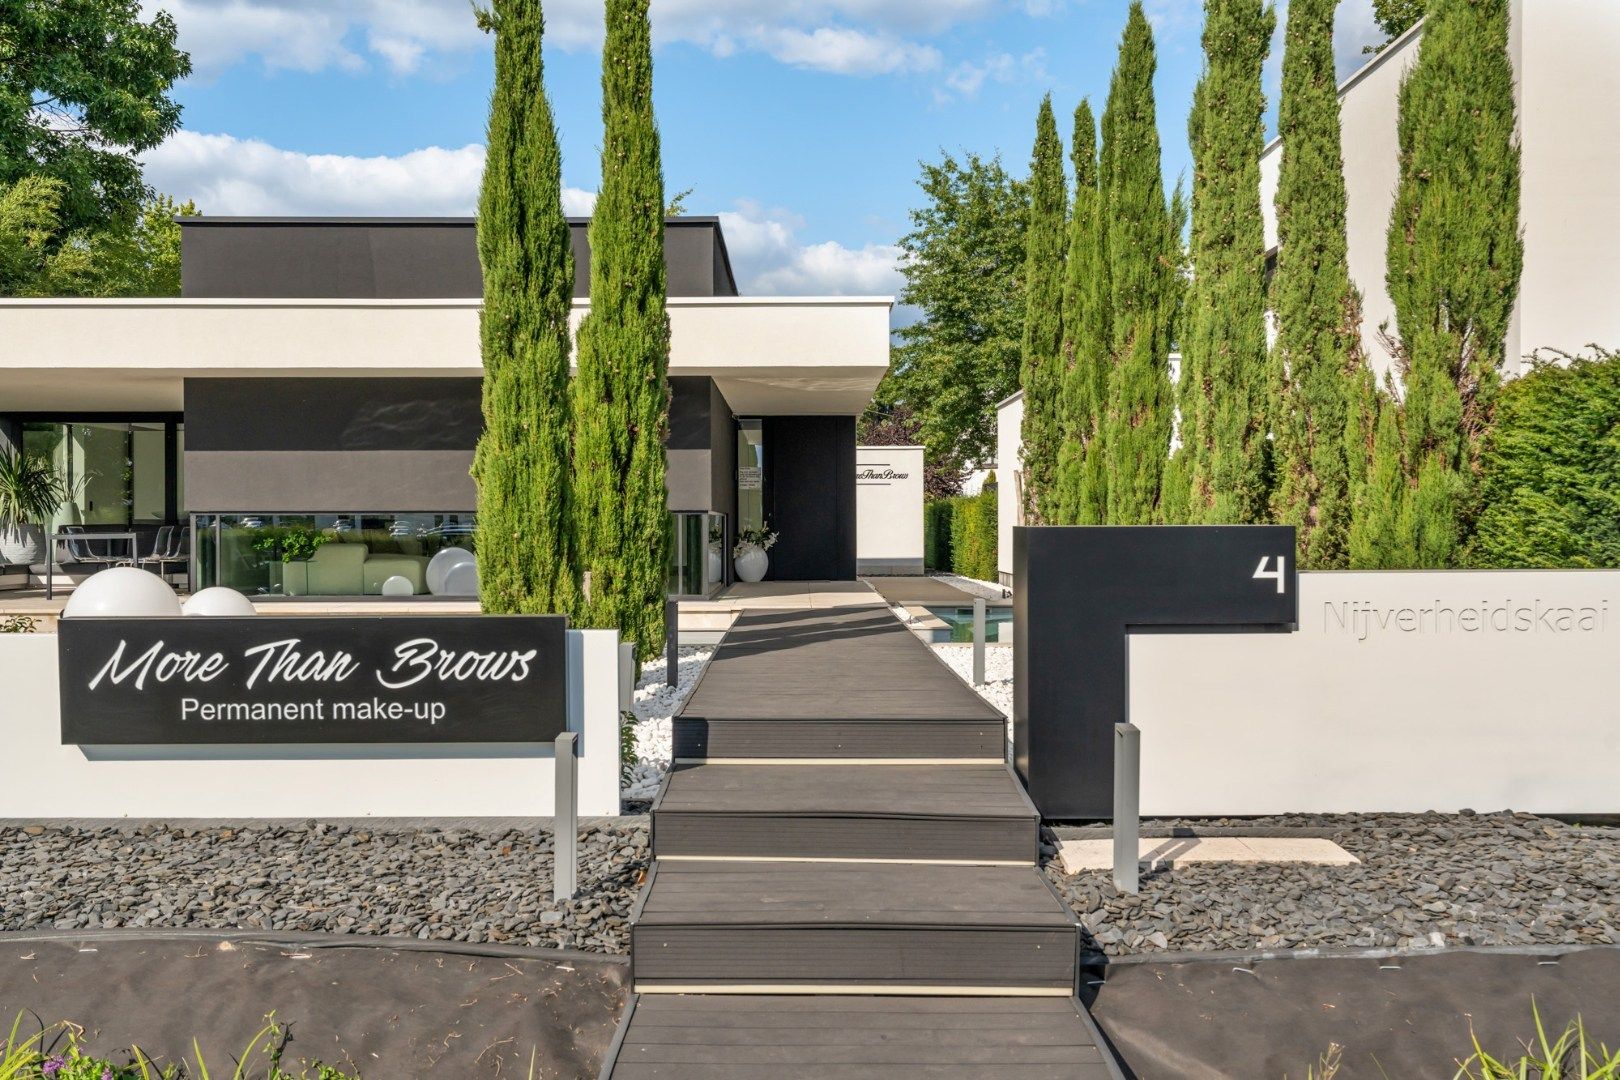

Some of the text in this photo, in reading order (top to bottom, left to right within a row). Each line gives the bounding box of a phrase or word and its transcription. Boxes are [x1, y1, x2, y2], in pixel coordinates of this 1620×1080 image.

[1251, 555, 1285, 594] 4
[1323, 599, 1608, 643] Nijverheidskaai
[88, 637, 538, 691] More Than Brows
[181, 696, 446, 725] Permanent make-up
